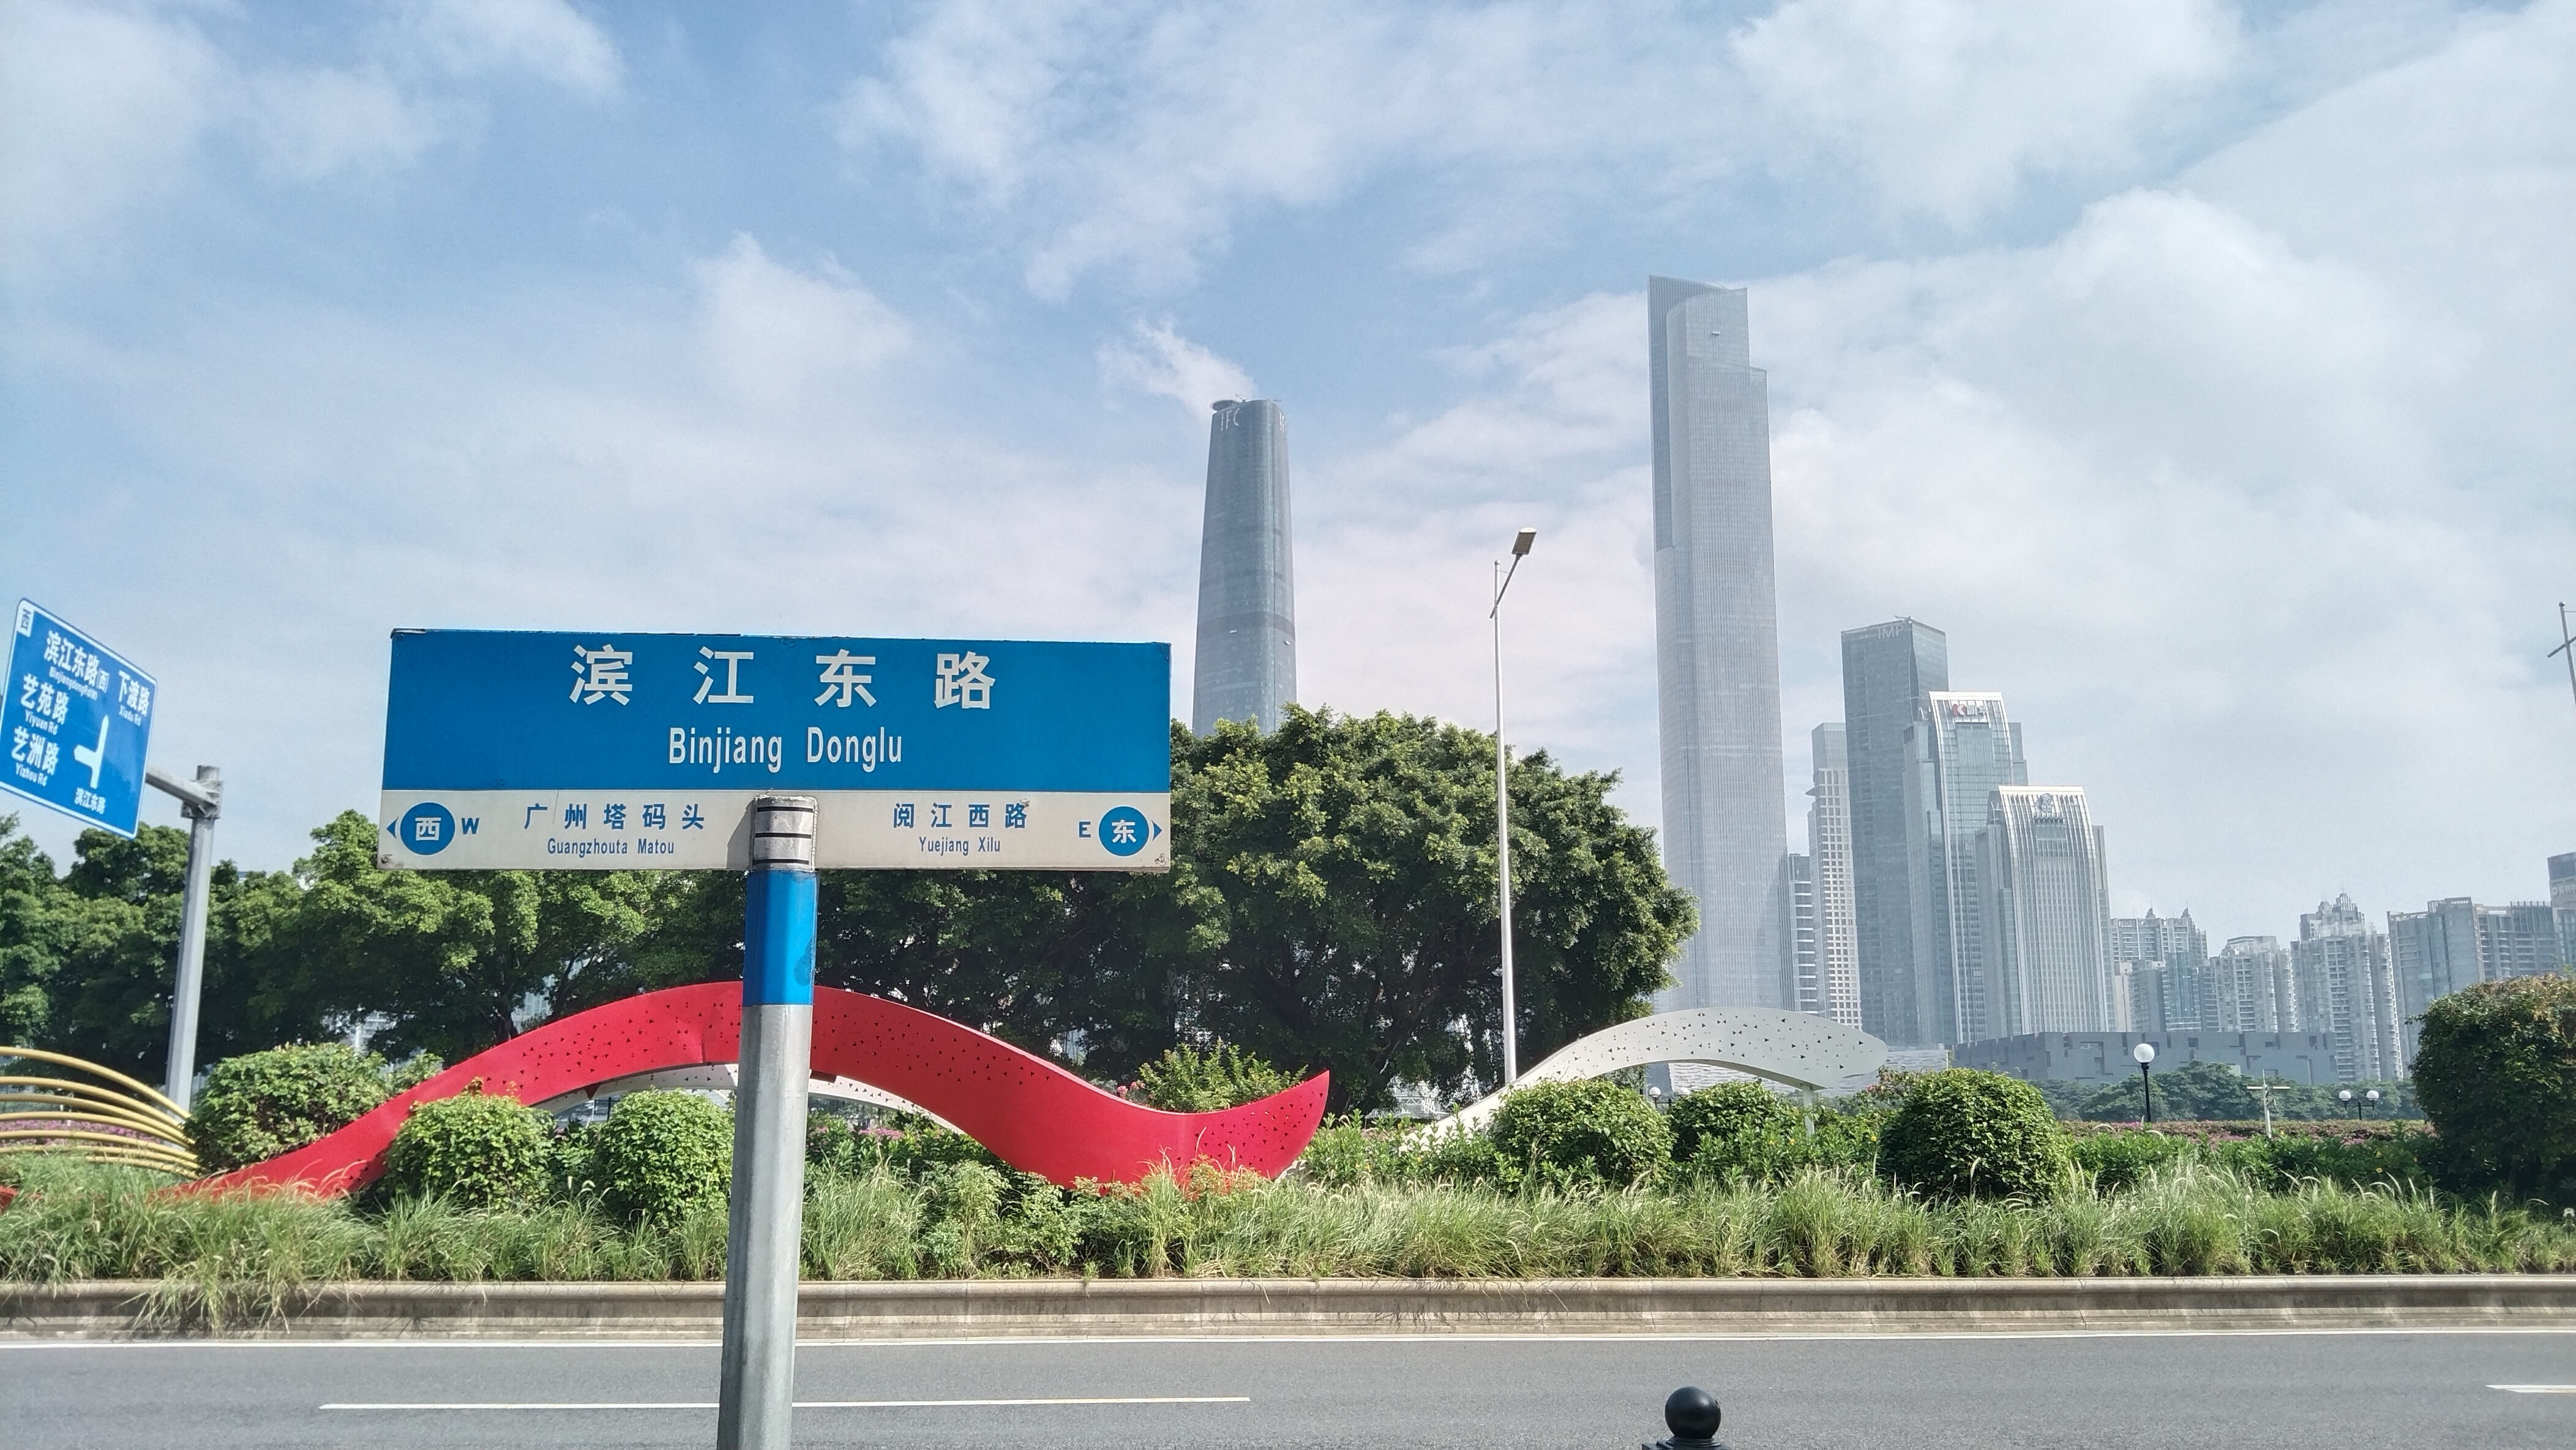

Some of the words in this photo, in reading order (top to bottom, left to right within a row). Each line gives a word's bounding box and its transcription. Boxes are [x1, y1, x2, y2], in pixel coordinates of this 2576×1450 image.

[1221, 408, 1240, 431] IFC
[21, 608, 31, 631] 西
[1878, 625, 1904, 639] IMP
[569, 644, 996, 709] 滨江东路
[21, 674, 69, 725] 艺苑路
[119, 670, 150, 717] 下渡路
[25, 708, 48, 729] Yiyuan
[48, 720, 58, 735] Rd
[134, 713, 141, 726] Rd
[11, 725, 60, 775] 艺洲路
[669, 727, 782, 773] Binjiang
[807, 726, 902, 773] Donglu
[16, 762, 38, 783] Yizhou
[37, 772, 48, 786] Rd
[74, 787, 107, 814] 滨江东路
[461, 817, 479, 835] W
[524, 803, 705, 830] 广州塔码头
[893, 802, 1028, 829] 阅江西路
[415, 817, 441, 841] 西
[1079, 821, 1091, 838] E
[1111, 819, 1137, 844] 东
[547, 838, 628, 858] Guangzhouta
[637, 838, 675, 855] Matou
[919, 836, 969, 856] Yuejiang
[978, 836, 1001, 852] Xilu
